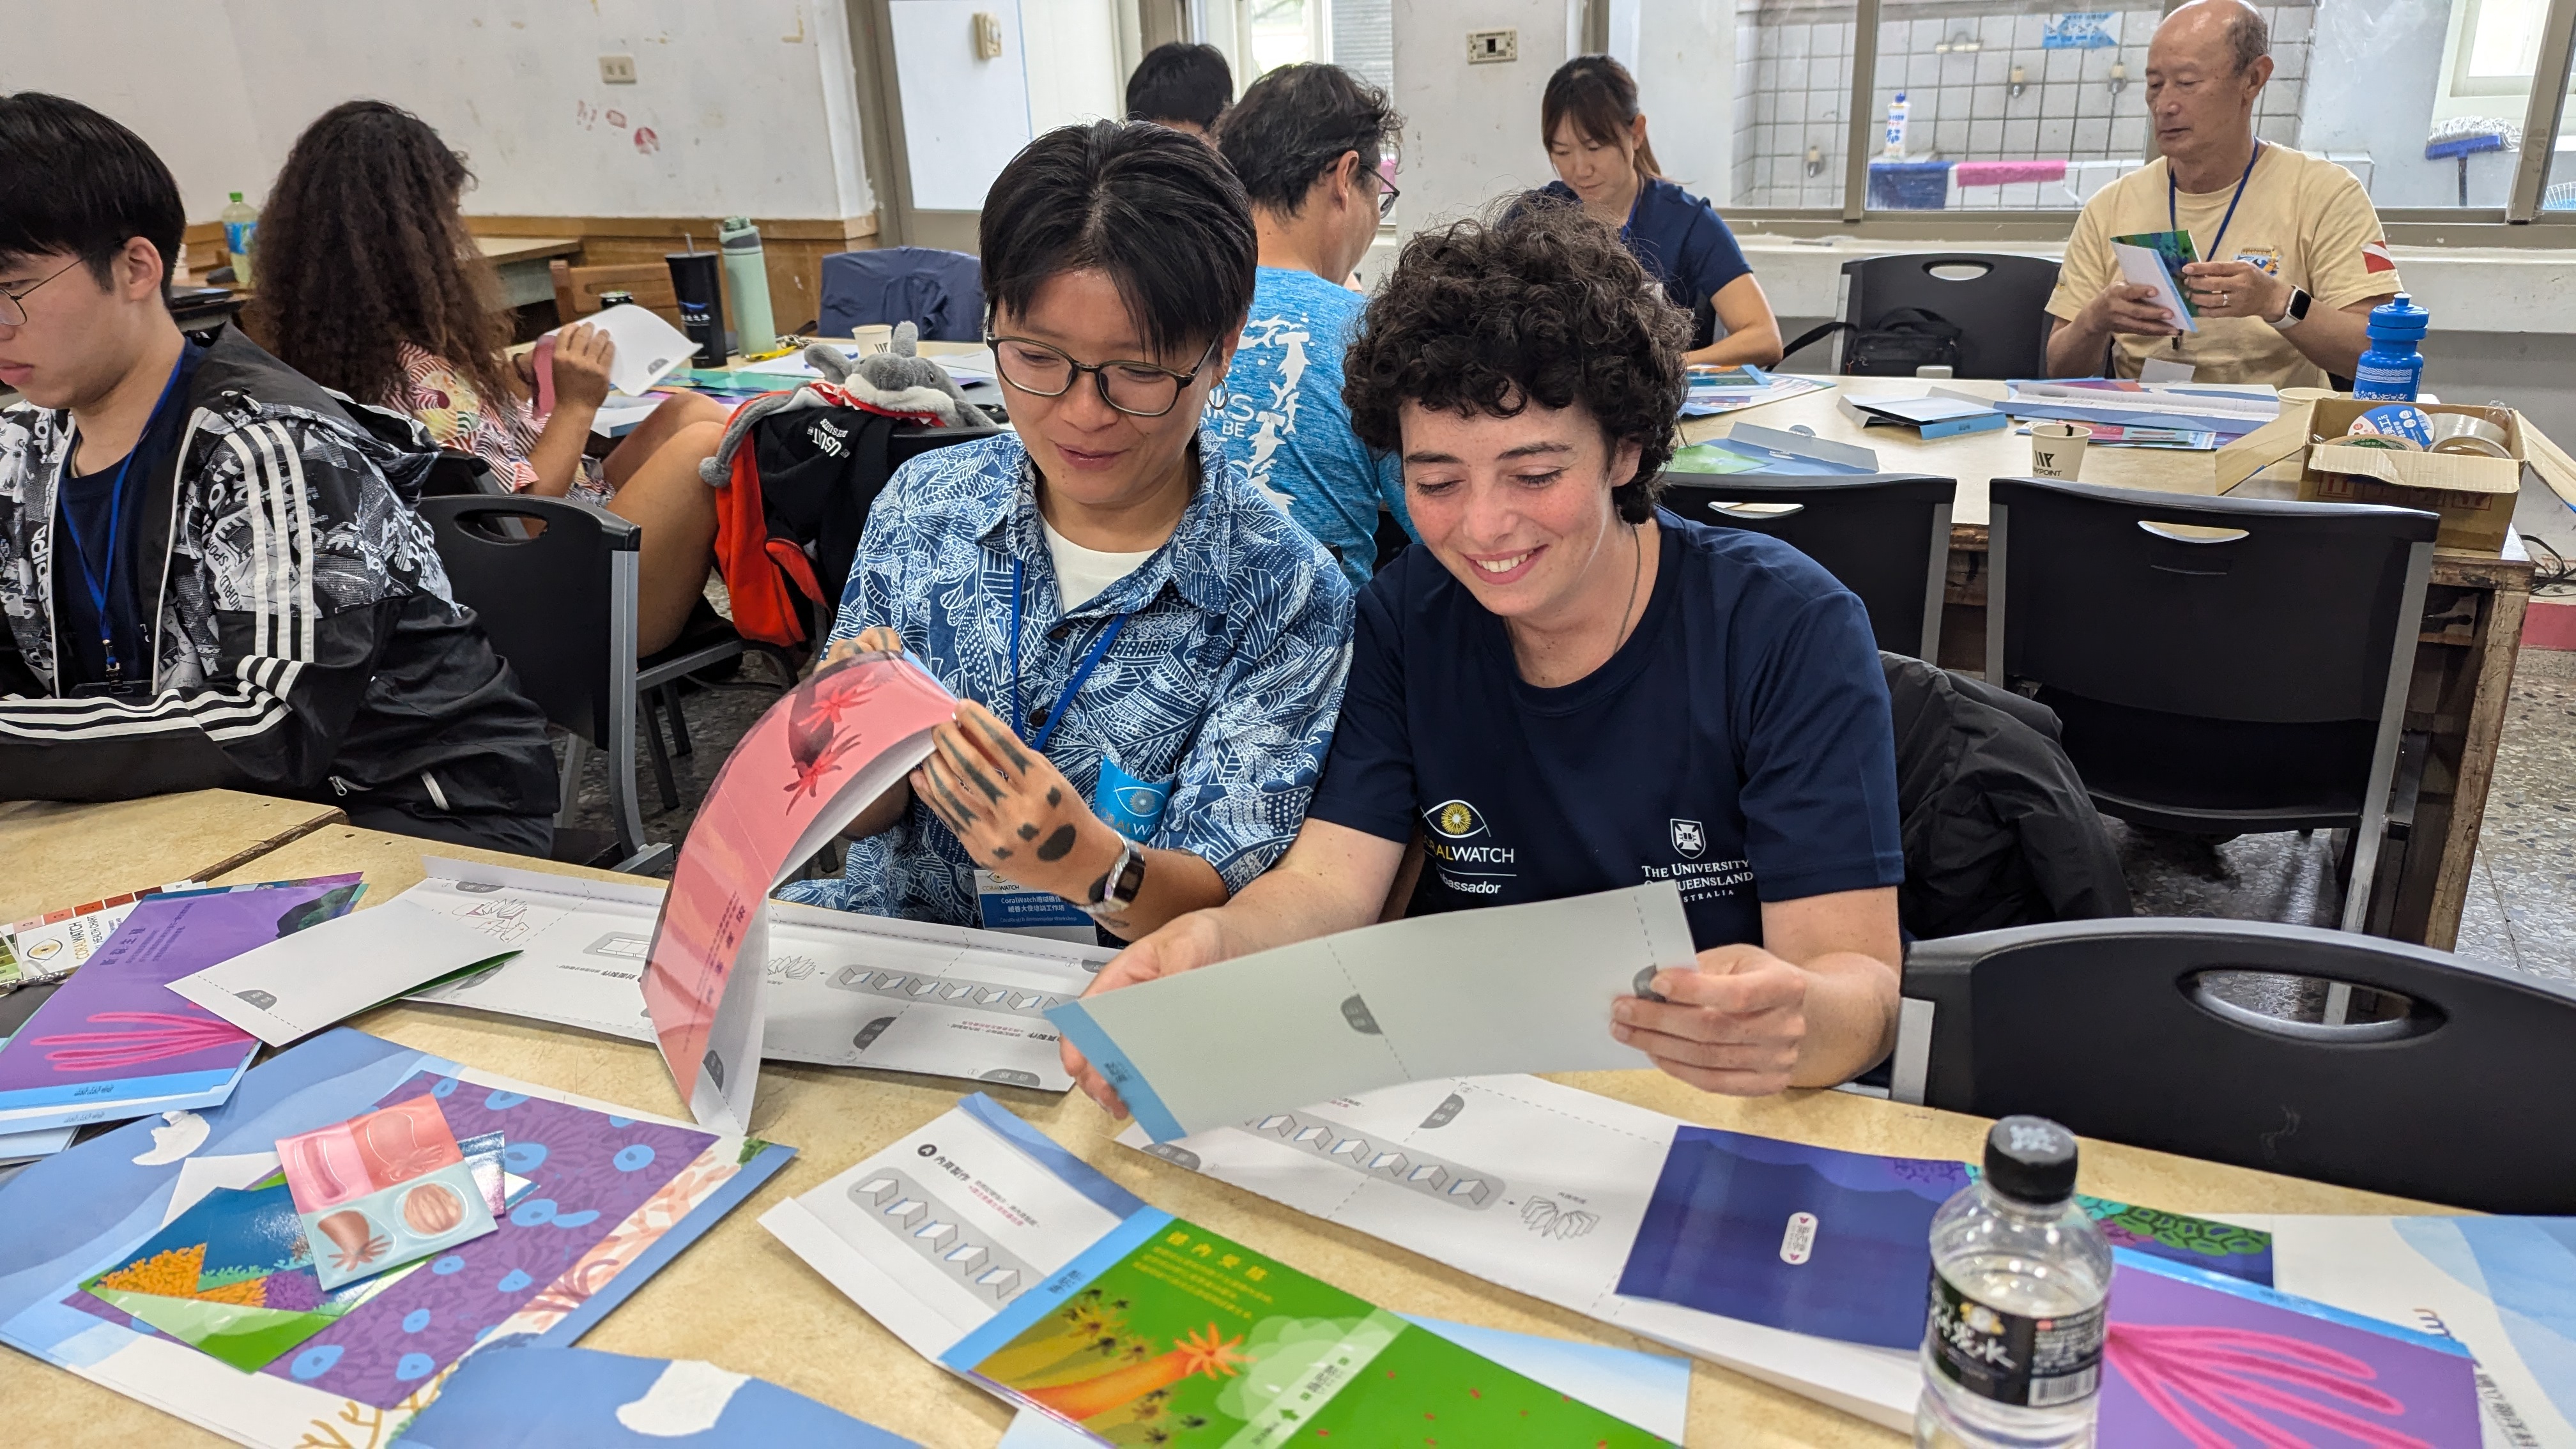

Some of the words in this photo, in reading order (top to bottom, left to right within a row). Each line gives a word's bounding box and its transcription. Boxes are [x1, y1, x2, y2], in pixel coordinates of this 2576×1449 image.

[1222, 420, 1246, 438] BE
[2034, 467, 2062, 477] YPOINT
[1423, 834, 1515, 864] ALWATCH
[1641, 865, 1669, 878] THE
[1671, 859, 1749, 876] UNIVERSITY
[1438, 869, 1501, 894] bassador
[1676, 871, 1754, 891] UEENSLAND
[1683, 890, 1735, 903] STRALIA
[68, 921, 89, 960] CORALWATCH
[1027, 1031, 1061, 1041] 頁製作
